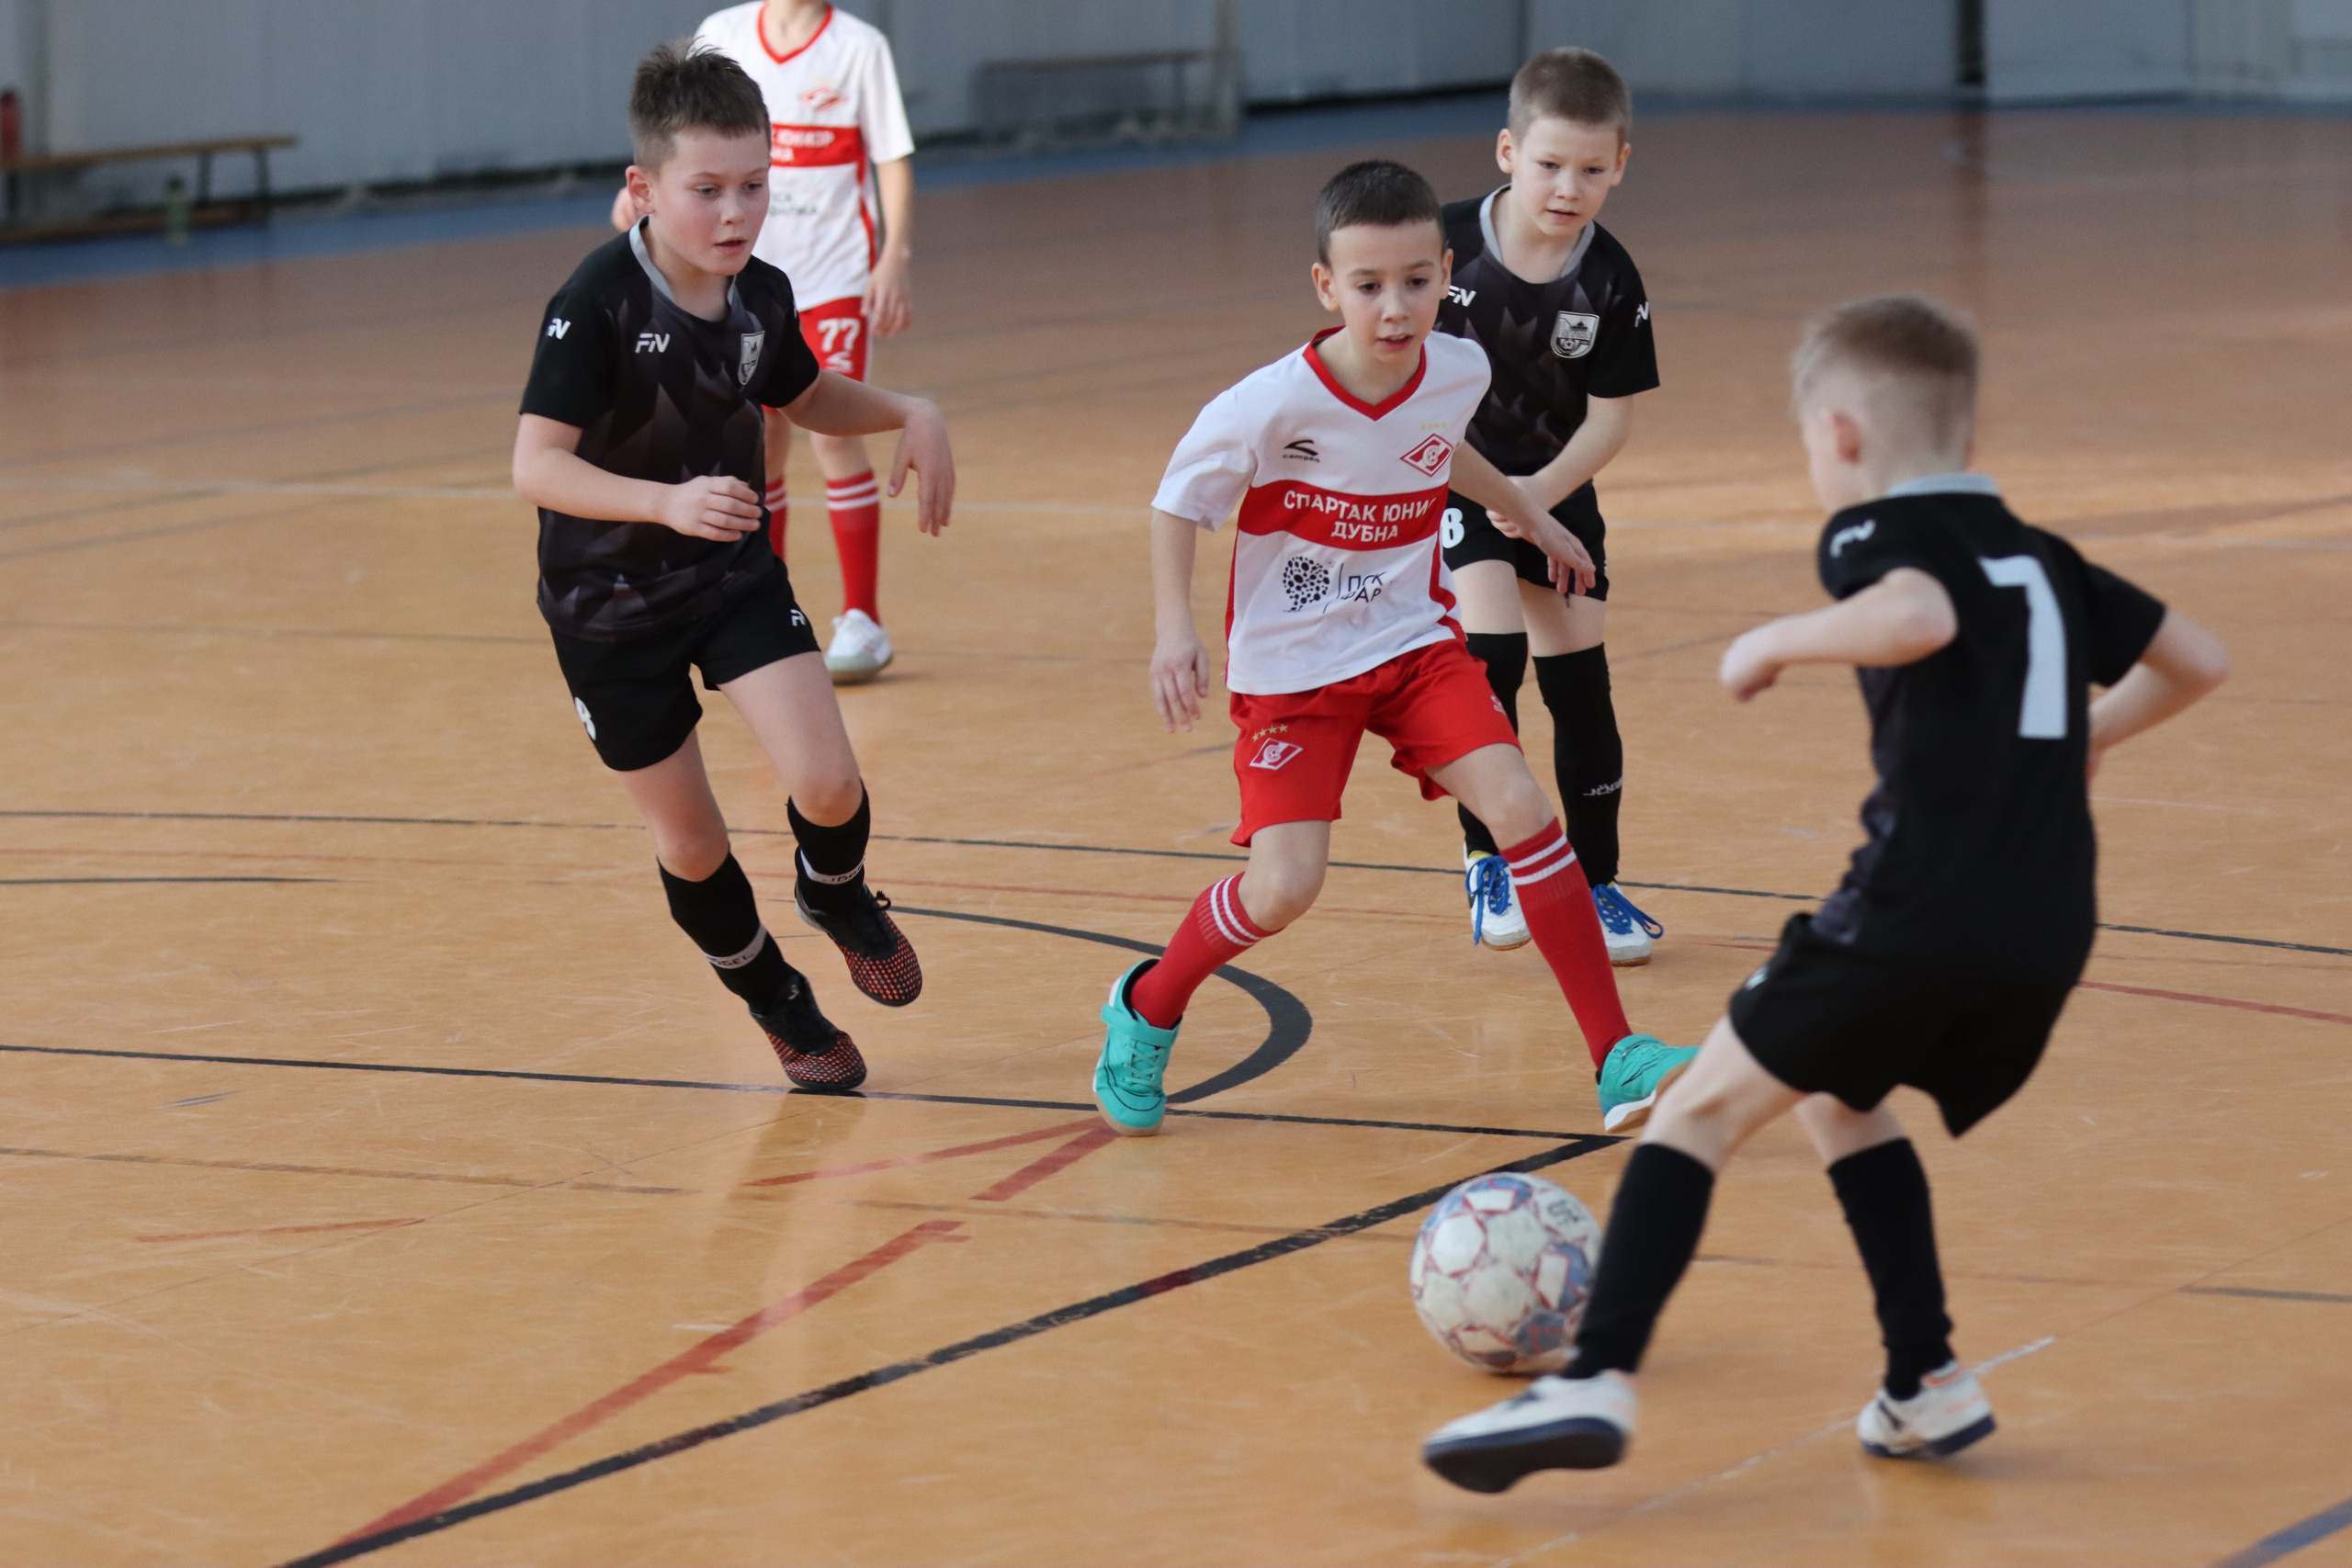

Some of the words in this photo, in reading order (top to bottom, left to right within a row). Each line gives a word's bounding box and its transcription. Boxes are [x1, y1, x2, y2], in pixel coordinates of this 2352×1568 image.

[635, 333, 671, 354] FN
[818, 318, 861, 353] 77
[1283, 490, 1377, 523] СПАРТАК
[1330, 521, 1398, 543] ДУБНА
[1977, 554, 2066, 740] 7
